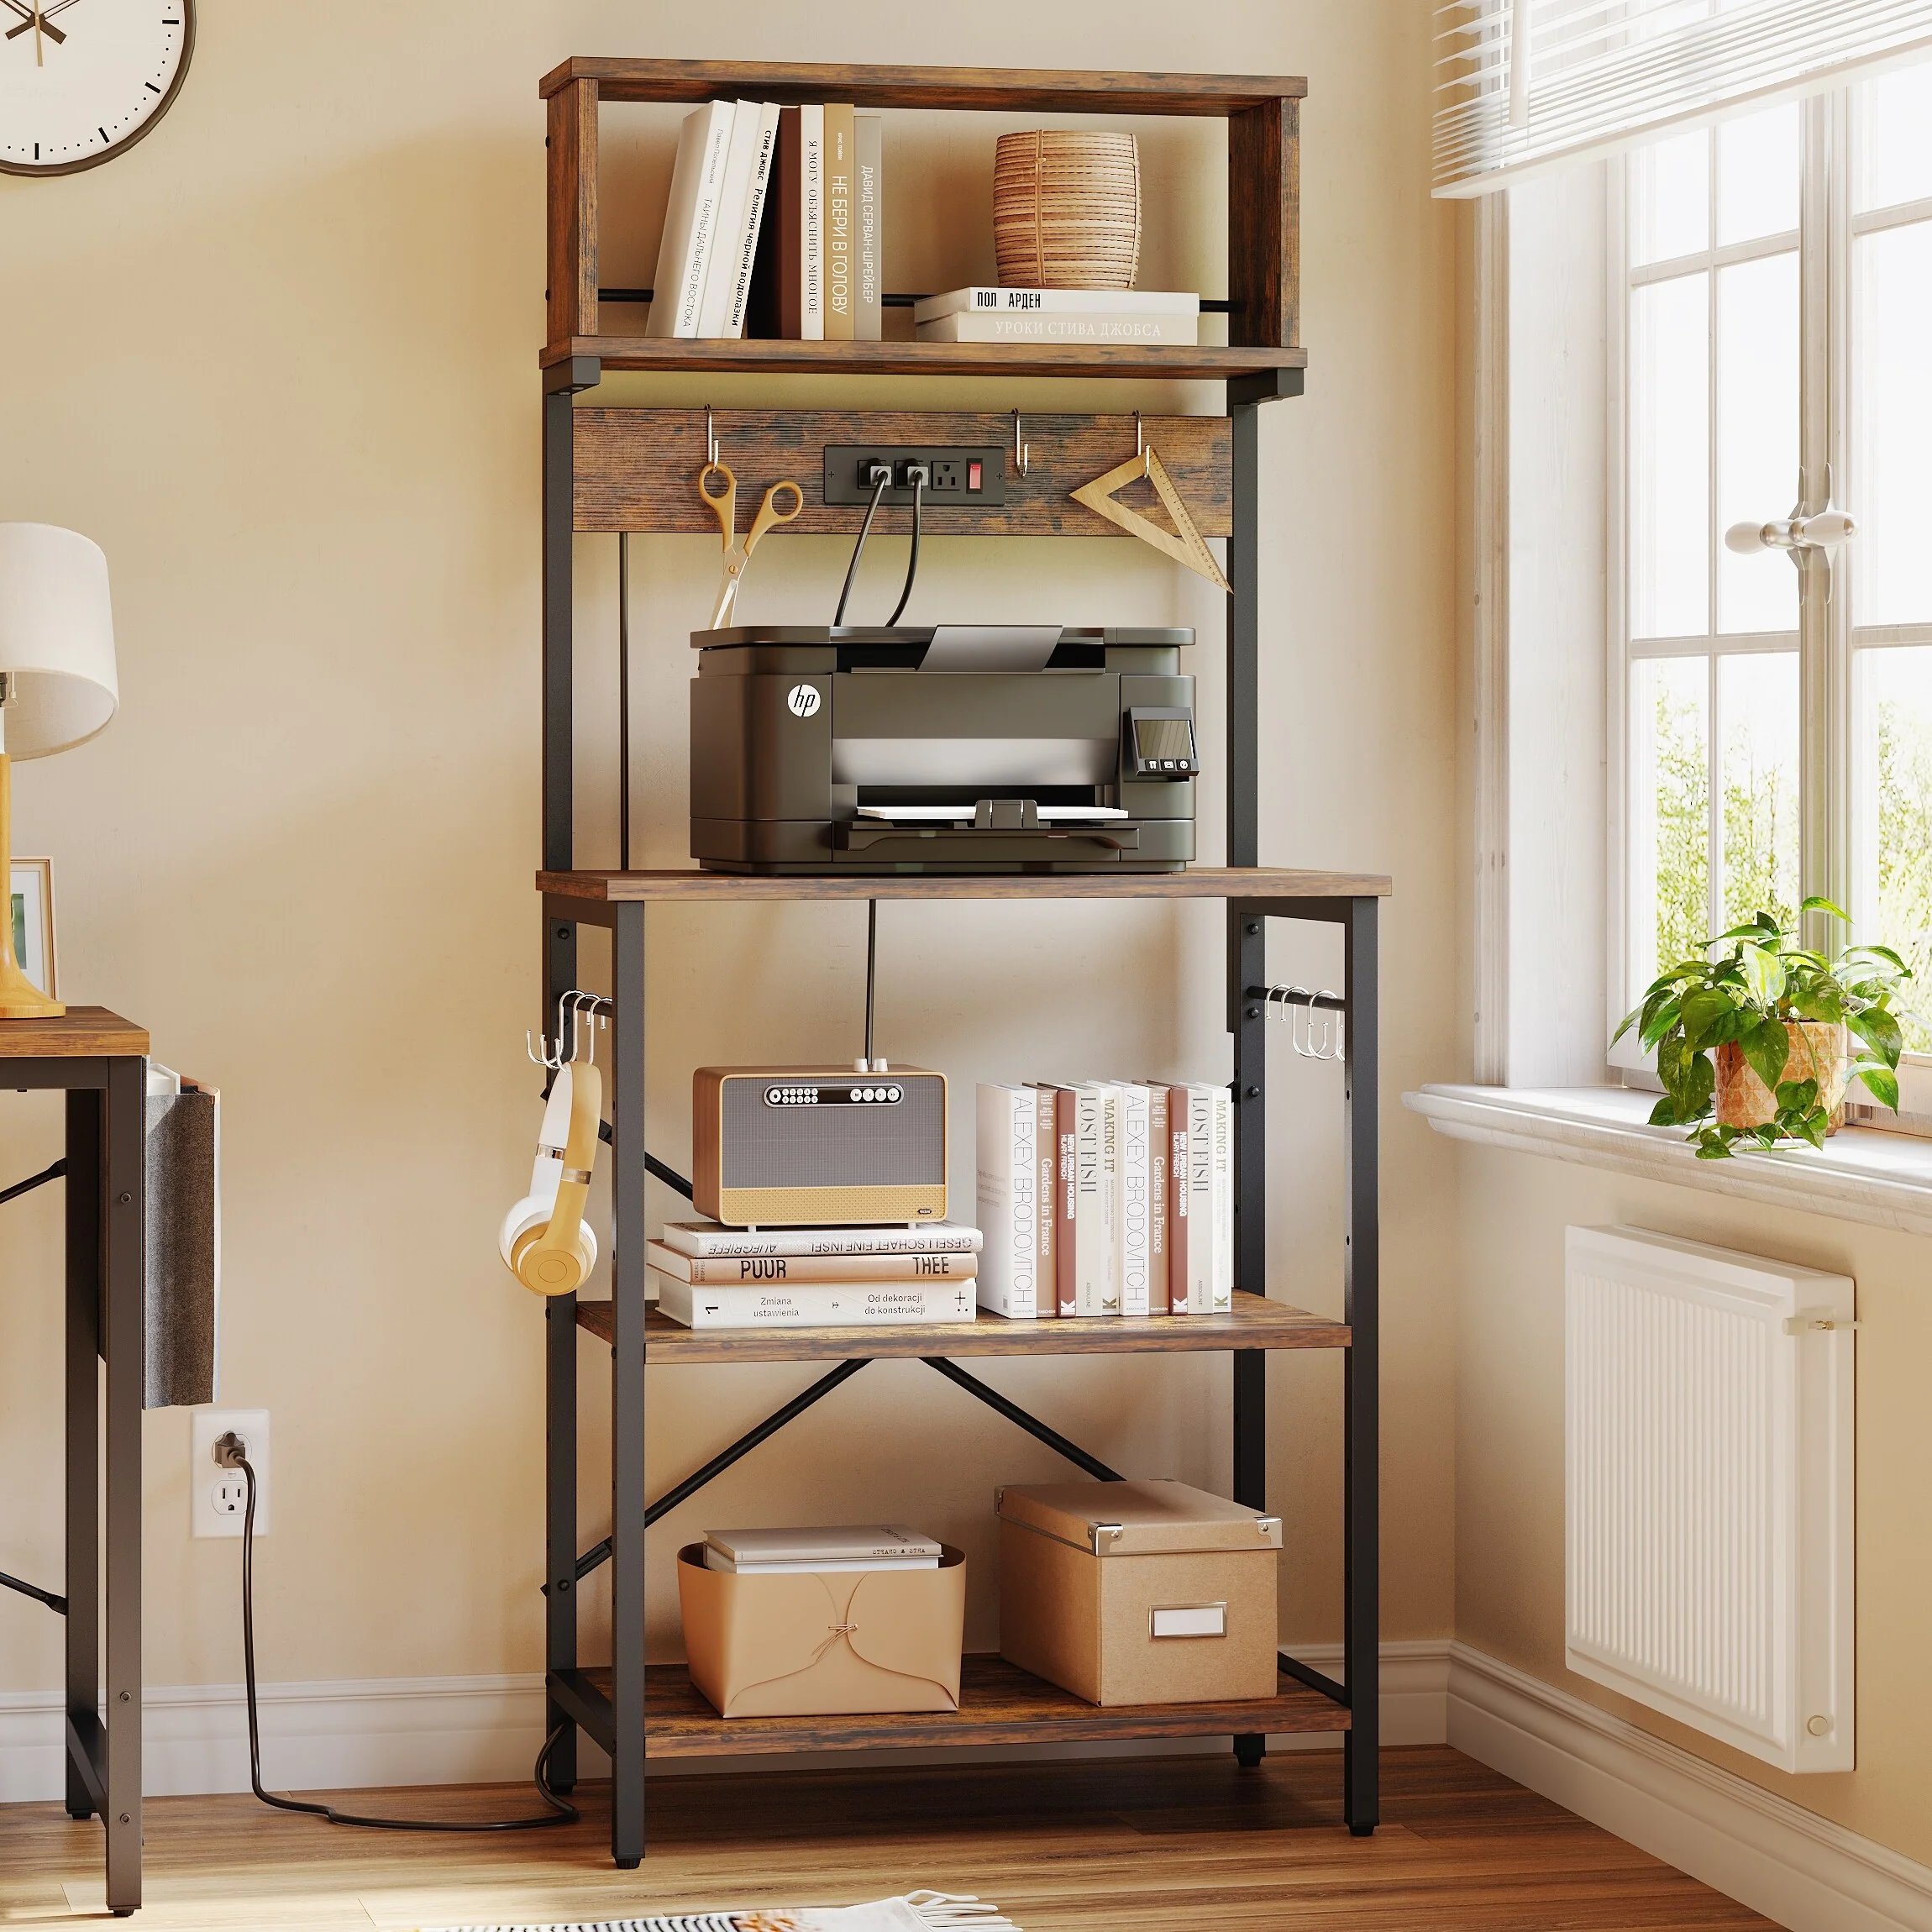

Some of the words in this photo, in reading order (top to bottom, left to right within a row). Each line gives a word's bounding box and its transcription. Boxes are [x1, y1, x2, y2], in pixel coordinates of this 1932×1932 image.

[808, 151, 818, 184] МОГУ
[832, 176, 847, 195] НЕ
[861, 166, 873, 202] ДАВИД
[748, 188, 763, 230] Религия
[808, 189, 817, 260] ОБЪЯСНИТЬ
[832, 199, 847, 237] БЕРИ
[690, 232, 706, 281] ДАЛЬНЕГО
[742, 233, 753, 269] черной
[832, 242, 847, 250] В
[864, 206, 875, 303] СЕРВАН-ШРЕЙБЕР
[732, 272, 746, 326] водолазки
[808, 265, 817, 314] МНОГОЕ
[832, 255, 847, 315] ГОЛОВУ
[977, 292, 997, 307] ПОЛ
[1008, 293, 1041, 309] АРДЕН
[683, 283, 697, 327] ВОСТОКА
[995, 321, 1043, 334] УРОКИ
[1048, 322, 1095, 336] СТИВА
[1100, 323, 1161, 338] ДЖОБСА
[794, 685, 816, 717] hp
[1013, 1096, 1032, 1171] ALEXEY
[1080, 1098, 1097, 1146] LOST
[1105, 1099, 1115, 1156] MAKING
[1126, 1095, 1145, 1169] ALEXEY
[1179, 1132, 1188, 1149] NEW
[1193, 1098, 1208, 1146] LOST
[1216, 1100, 1226, 1154] MAKING
[1067, 1134, 1075, 1152] NEW
[1041, 1158, 1053, 1203] Gardens
[1067, 1152, 1075, 1182] URBAN
[1080, 1152, 1096, 1193] FISH
[1105, 1159, 1115, 1173] IT
[1153, 1156, 1165, 1201] Gardens
[1179, 1151, 1188, 1179] URBAN
[1193, 1152, 1208, 1191] FISH
[1216, 1159, 1226, 1172] IT
[1042, 1205, 1053, 1216] in
[1067, 1183, 1075, 1220] HOUSING
[1153, 1203, 1165, 1215] in
[1179, 1180, 1188, 1216] HOUSING
[1013, 1178, 1032, 1303] BRODOVITCH
[1041, 1218, 1053, 1256] France
[1126, 1177, 1145, 1300] BRODOVITCH
[1153, 1216, 1165, 1253] France
[741, 1260, 786, 1278] PUUR
[912, 1257, 949, 1275] THEE
[753, 1309, 800, 1317] ustawienia
[761, 1297, 792, 1305] Zmiana
[868, 1294, 880, 1303] Od
[882, 1294, 922, 1304] dekoracji
[877, 1305, 926, 1315] konstrukcji
